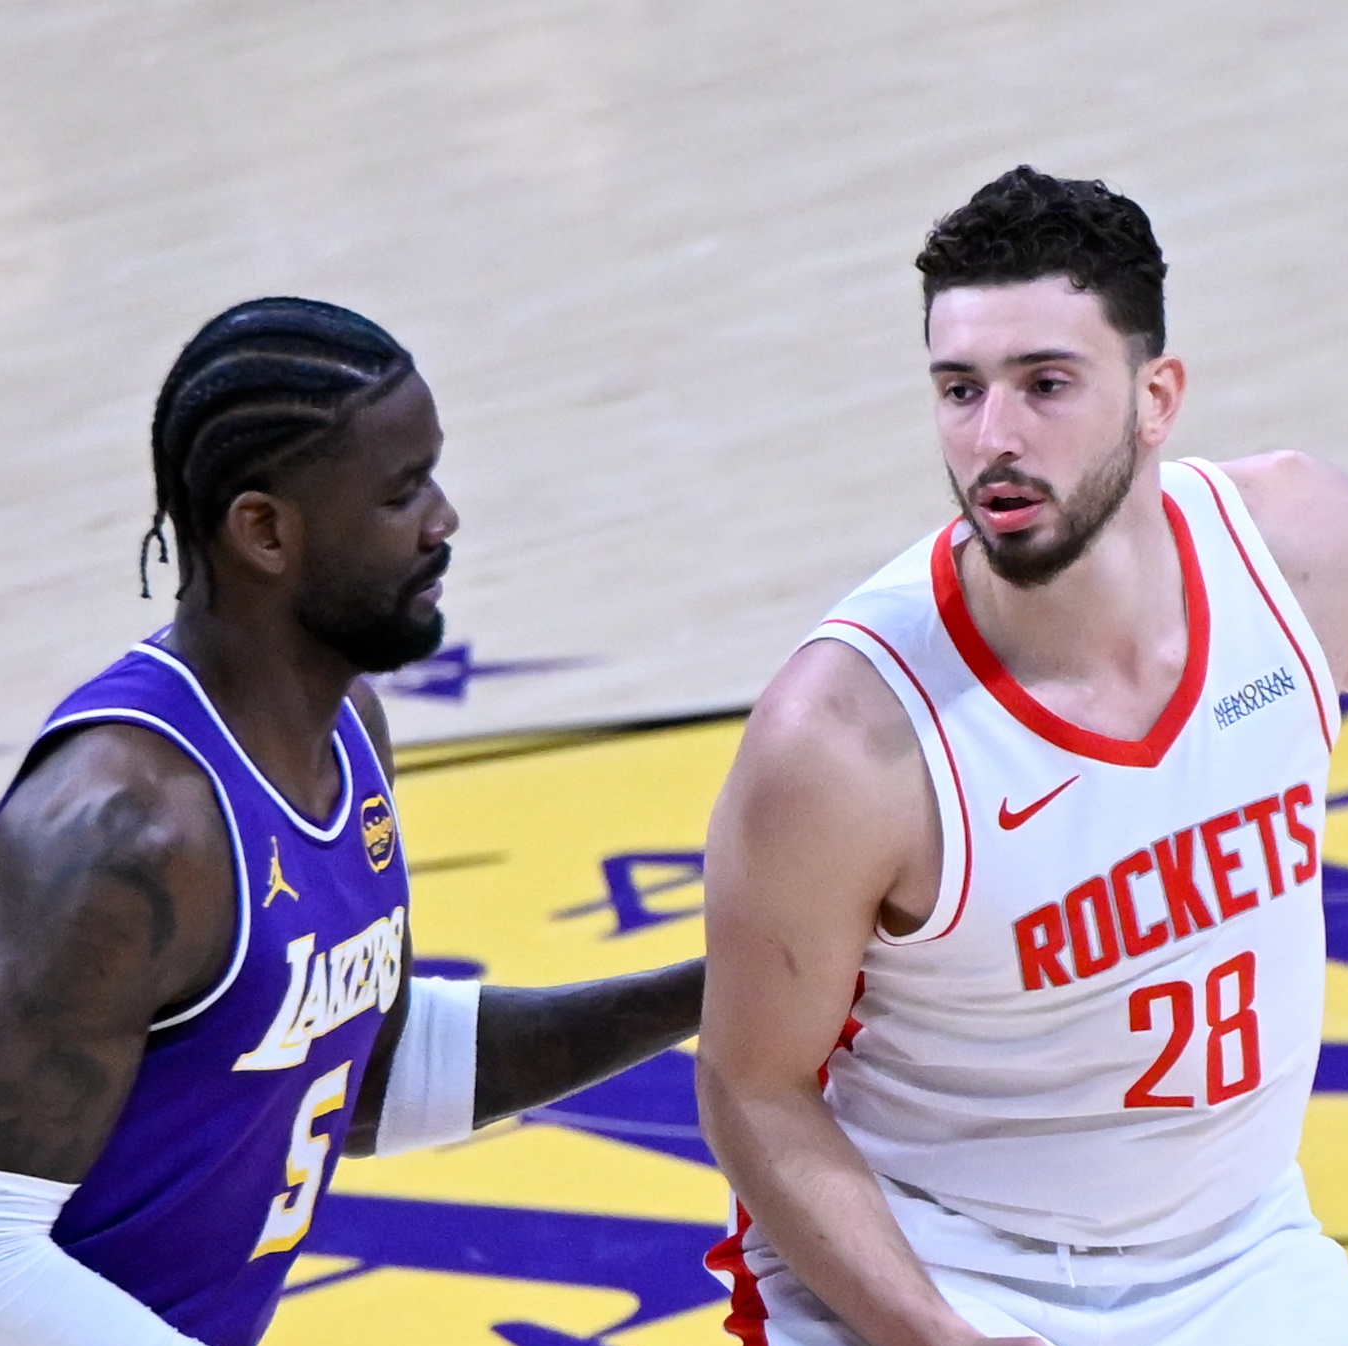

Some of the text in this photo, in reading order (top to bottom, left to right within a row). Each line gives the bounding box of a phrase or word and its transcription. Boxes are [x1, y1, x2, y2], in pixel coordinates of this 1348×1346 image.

[1213, 666, 1293, 717] MEMORIAL
[1215, 679, 1296, 731] HERMANN
[1011, 780, 1319, 992] ROCKETS
[231, 905, 405, 1072] LAKERS
[1124, 950, 1262, 1109] 28
[248, 1059, 352, 1262] 5
